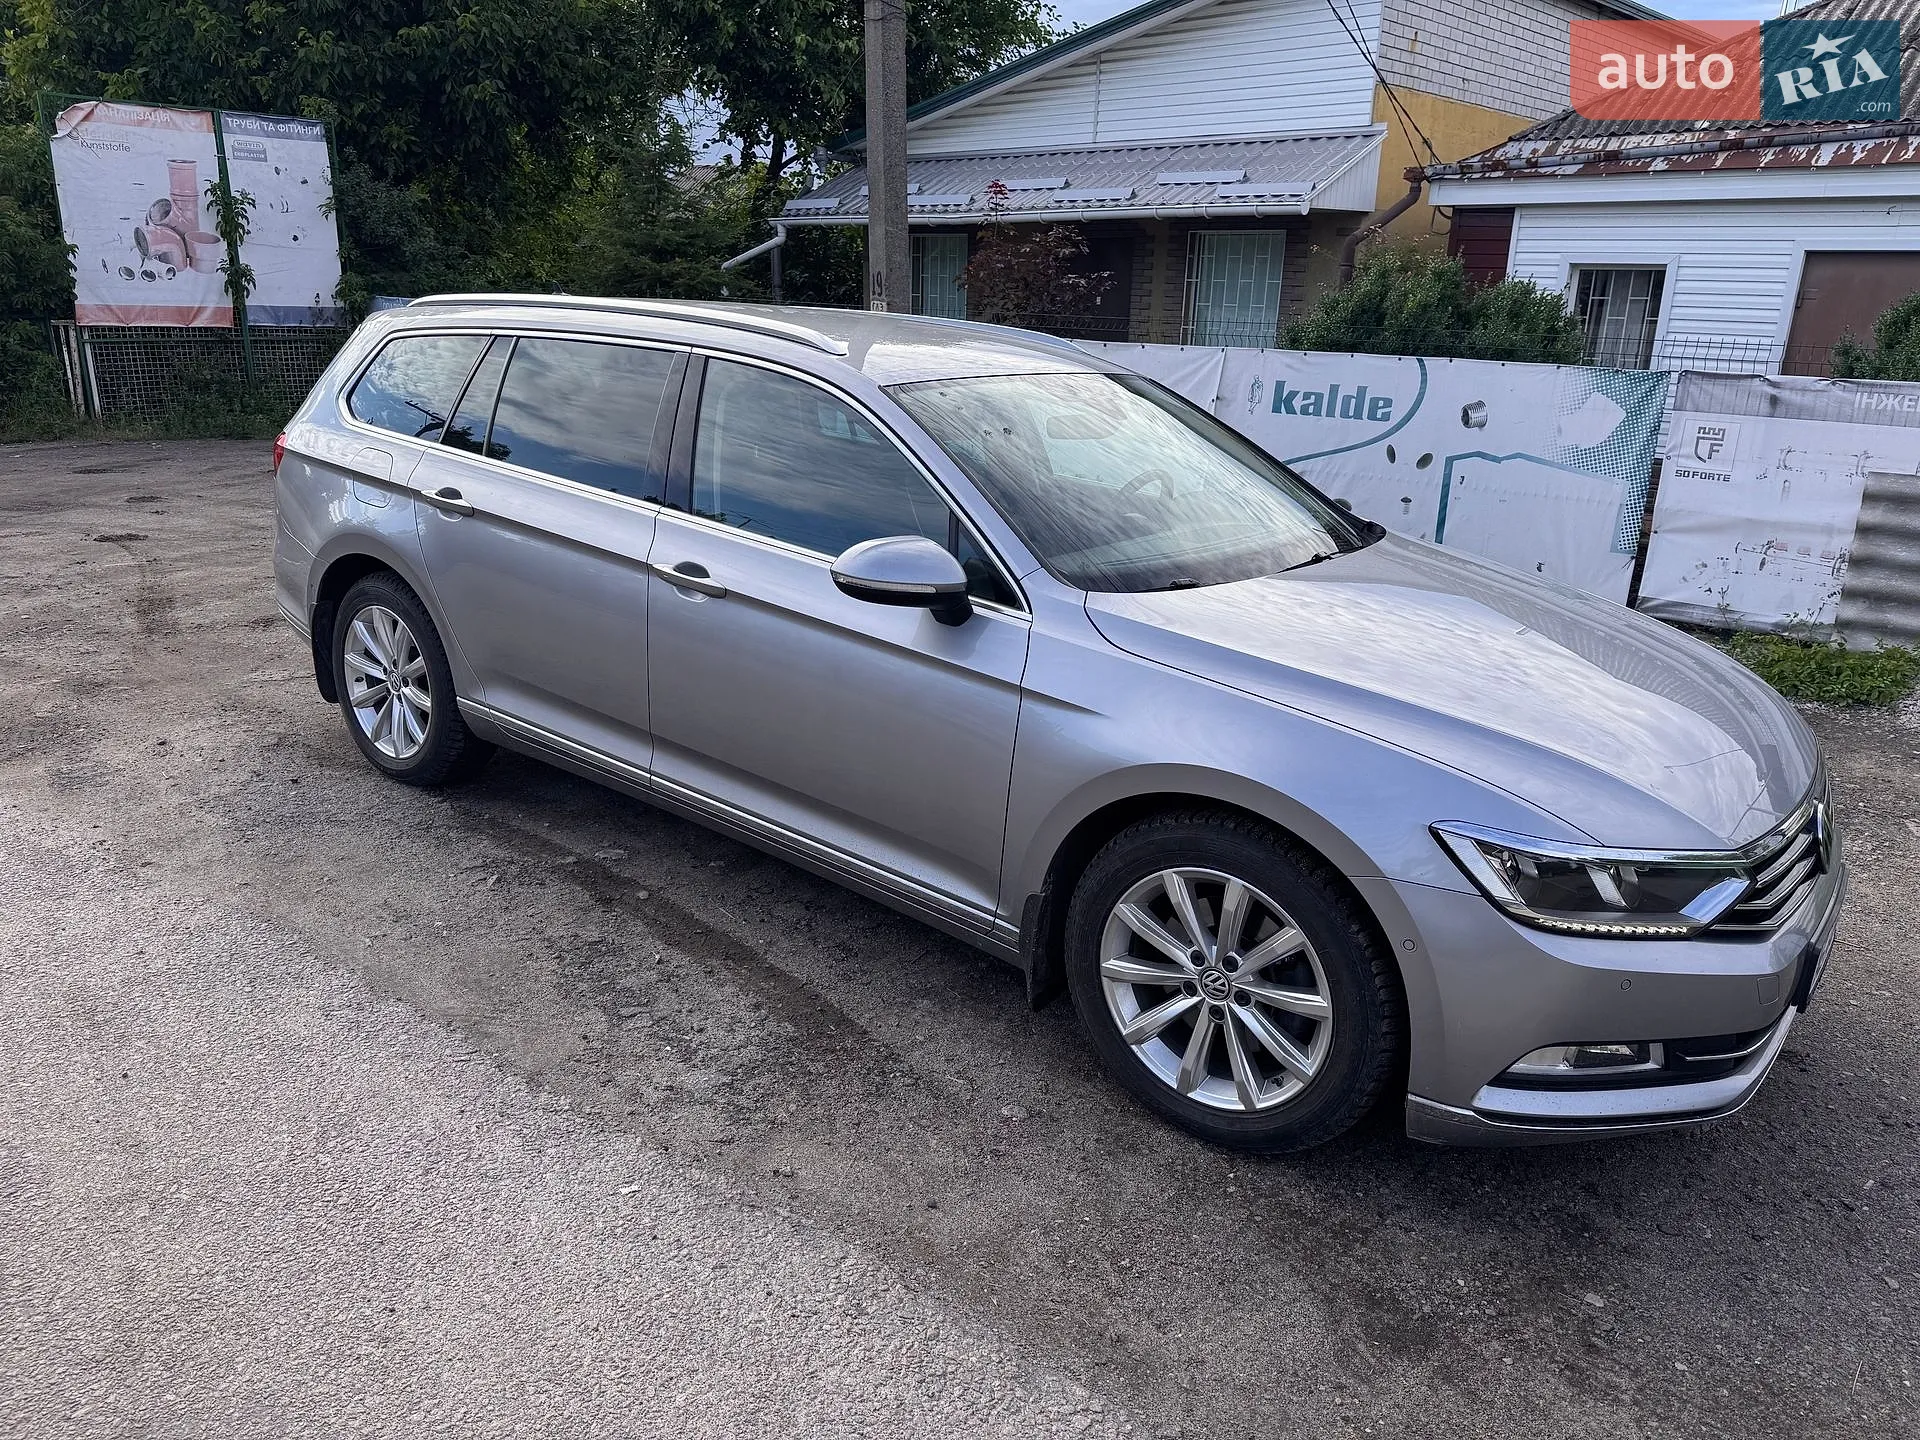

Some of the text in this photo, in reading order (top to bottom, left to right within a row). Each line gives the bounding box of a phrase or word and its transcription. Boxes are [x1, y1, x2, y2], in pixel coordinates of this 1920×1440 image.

[225, 117, 320, 135] ТРУБИ ТА ФІТИНГИ
[80, 140, 131, 152] Kunststoffe
[872, 271, 883, 297] 19
[1271, 380, 1394, 422] kalde
[1854, 392, 1920, 413] ІНЖЕ
